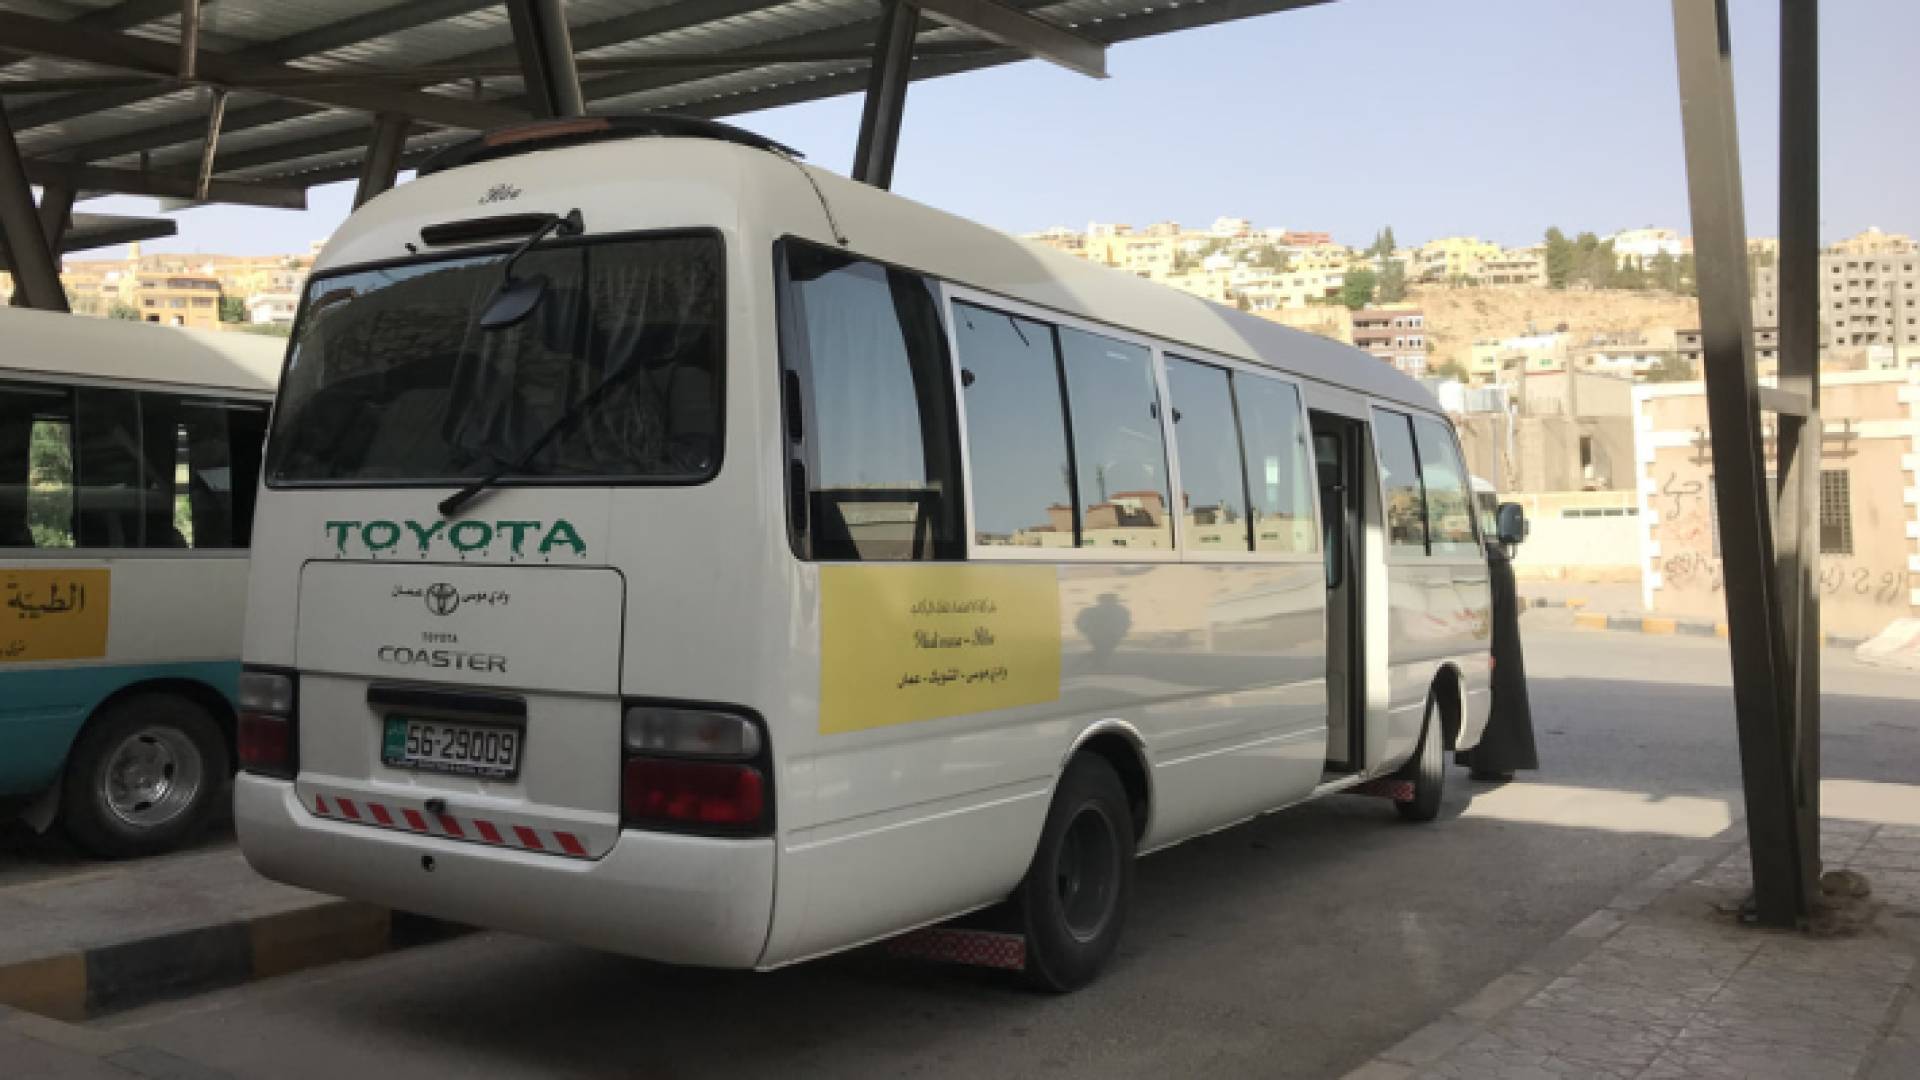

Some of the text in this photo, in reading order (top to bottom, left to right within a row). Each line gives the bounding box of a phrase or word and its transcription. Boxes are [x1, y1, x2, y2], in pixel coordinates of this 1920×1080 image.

[326, 519, 587, 557] TOYOTA
[377, 645, 507, 674] COASTER
[406, 725, 514, 765] 56-29009
